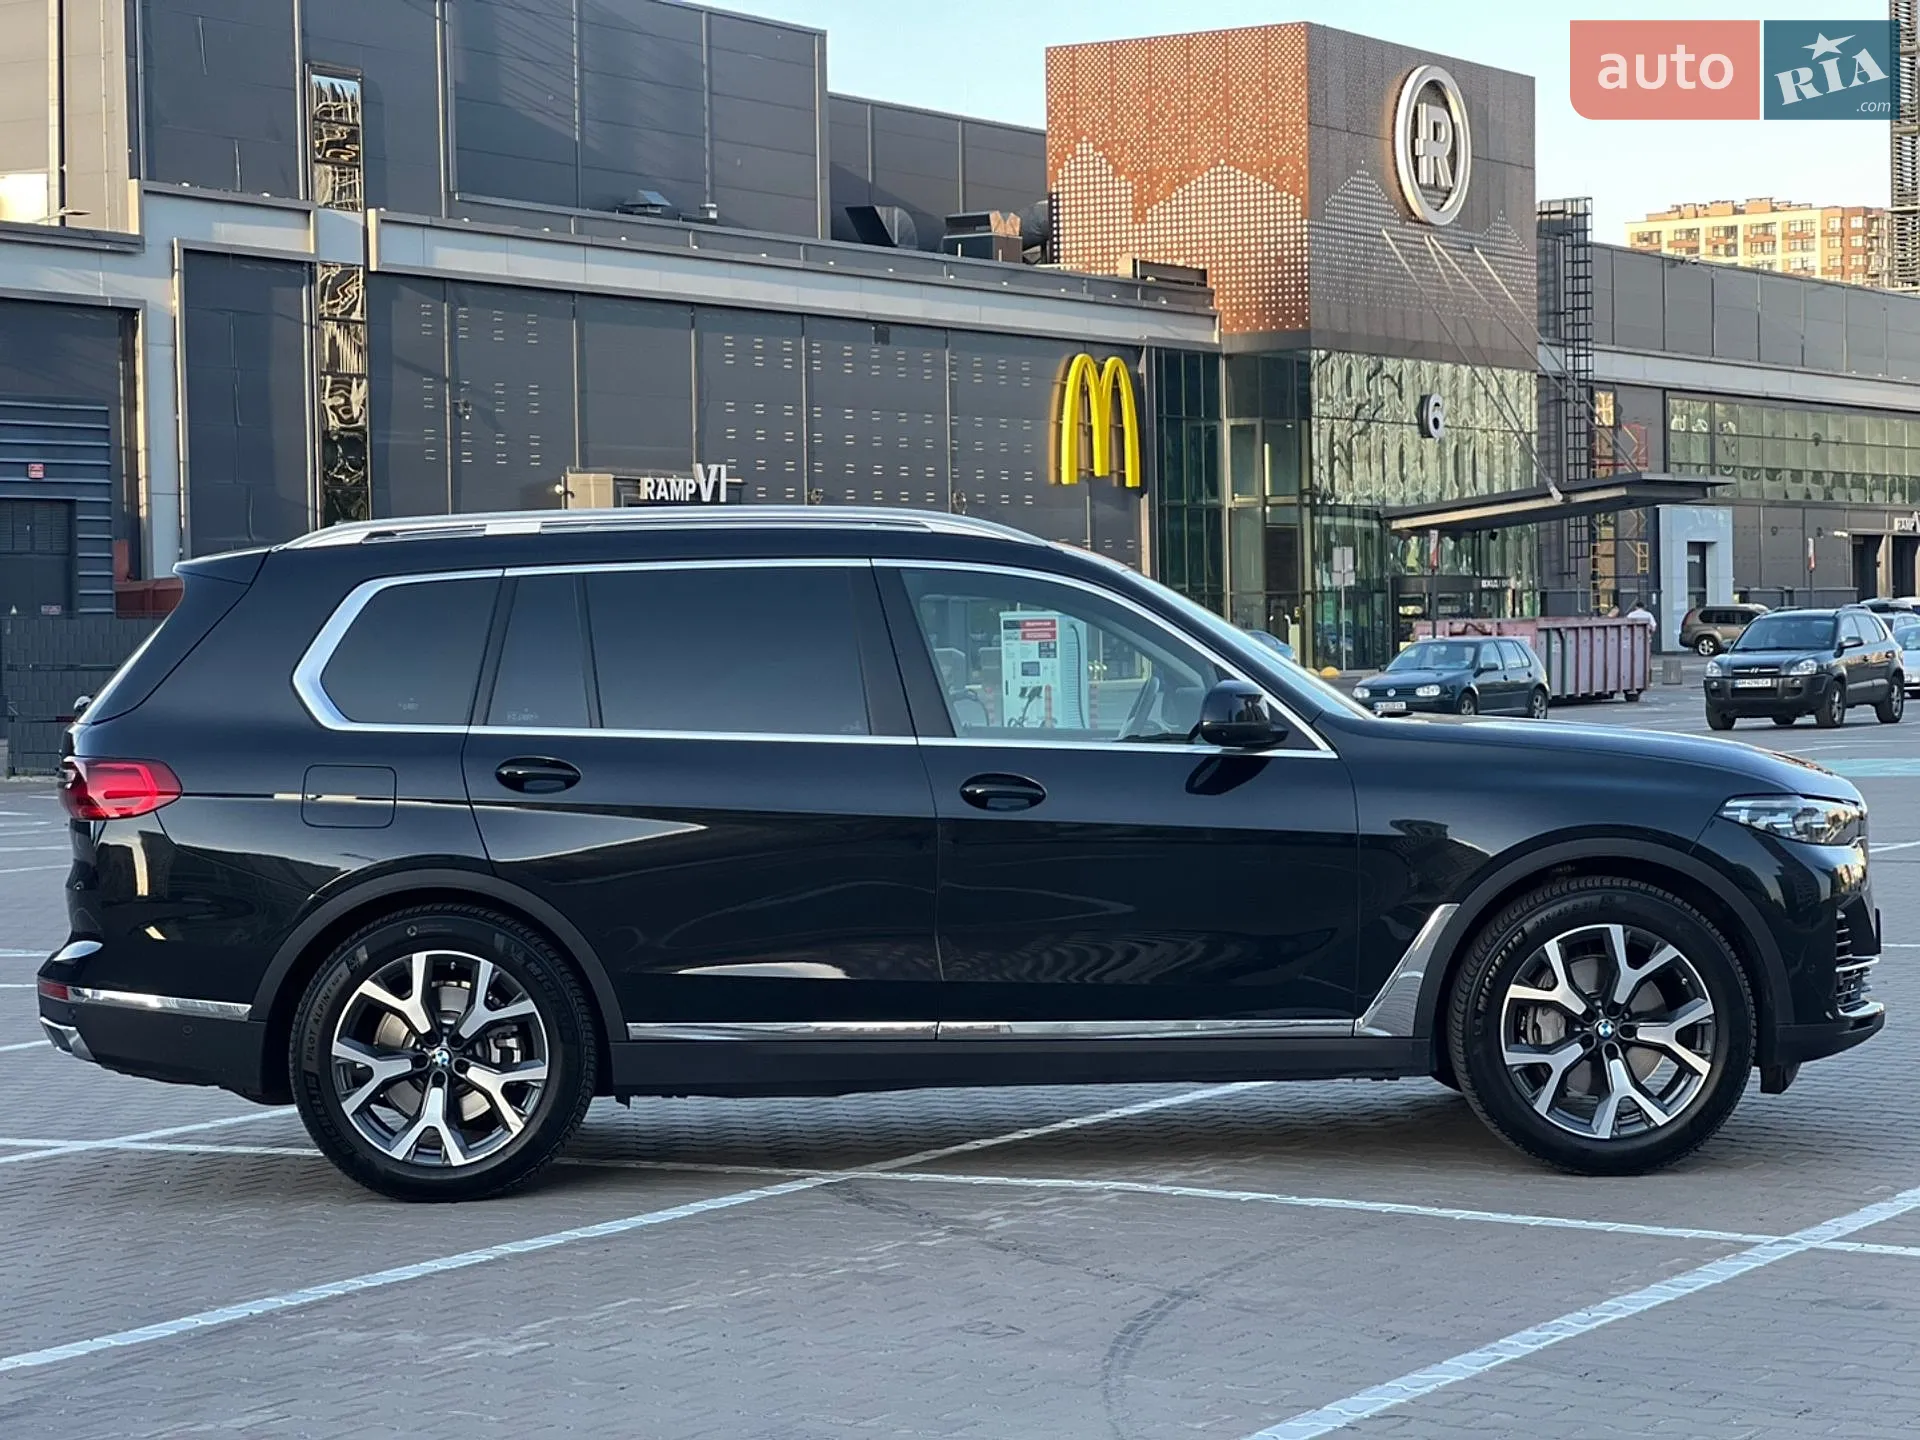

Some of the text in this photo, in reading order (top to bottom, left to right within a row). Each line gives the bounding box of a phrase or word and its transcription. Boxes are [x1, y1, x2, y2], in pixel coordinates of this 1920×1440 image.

[1424, 393, 1444, 439] 6
[640, 463, 727, 503] RAMP VI
[1476, 929, 1526, 1013] MICHELIN
